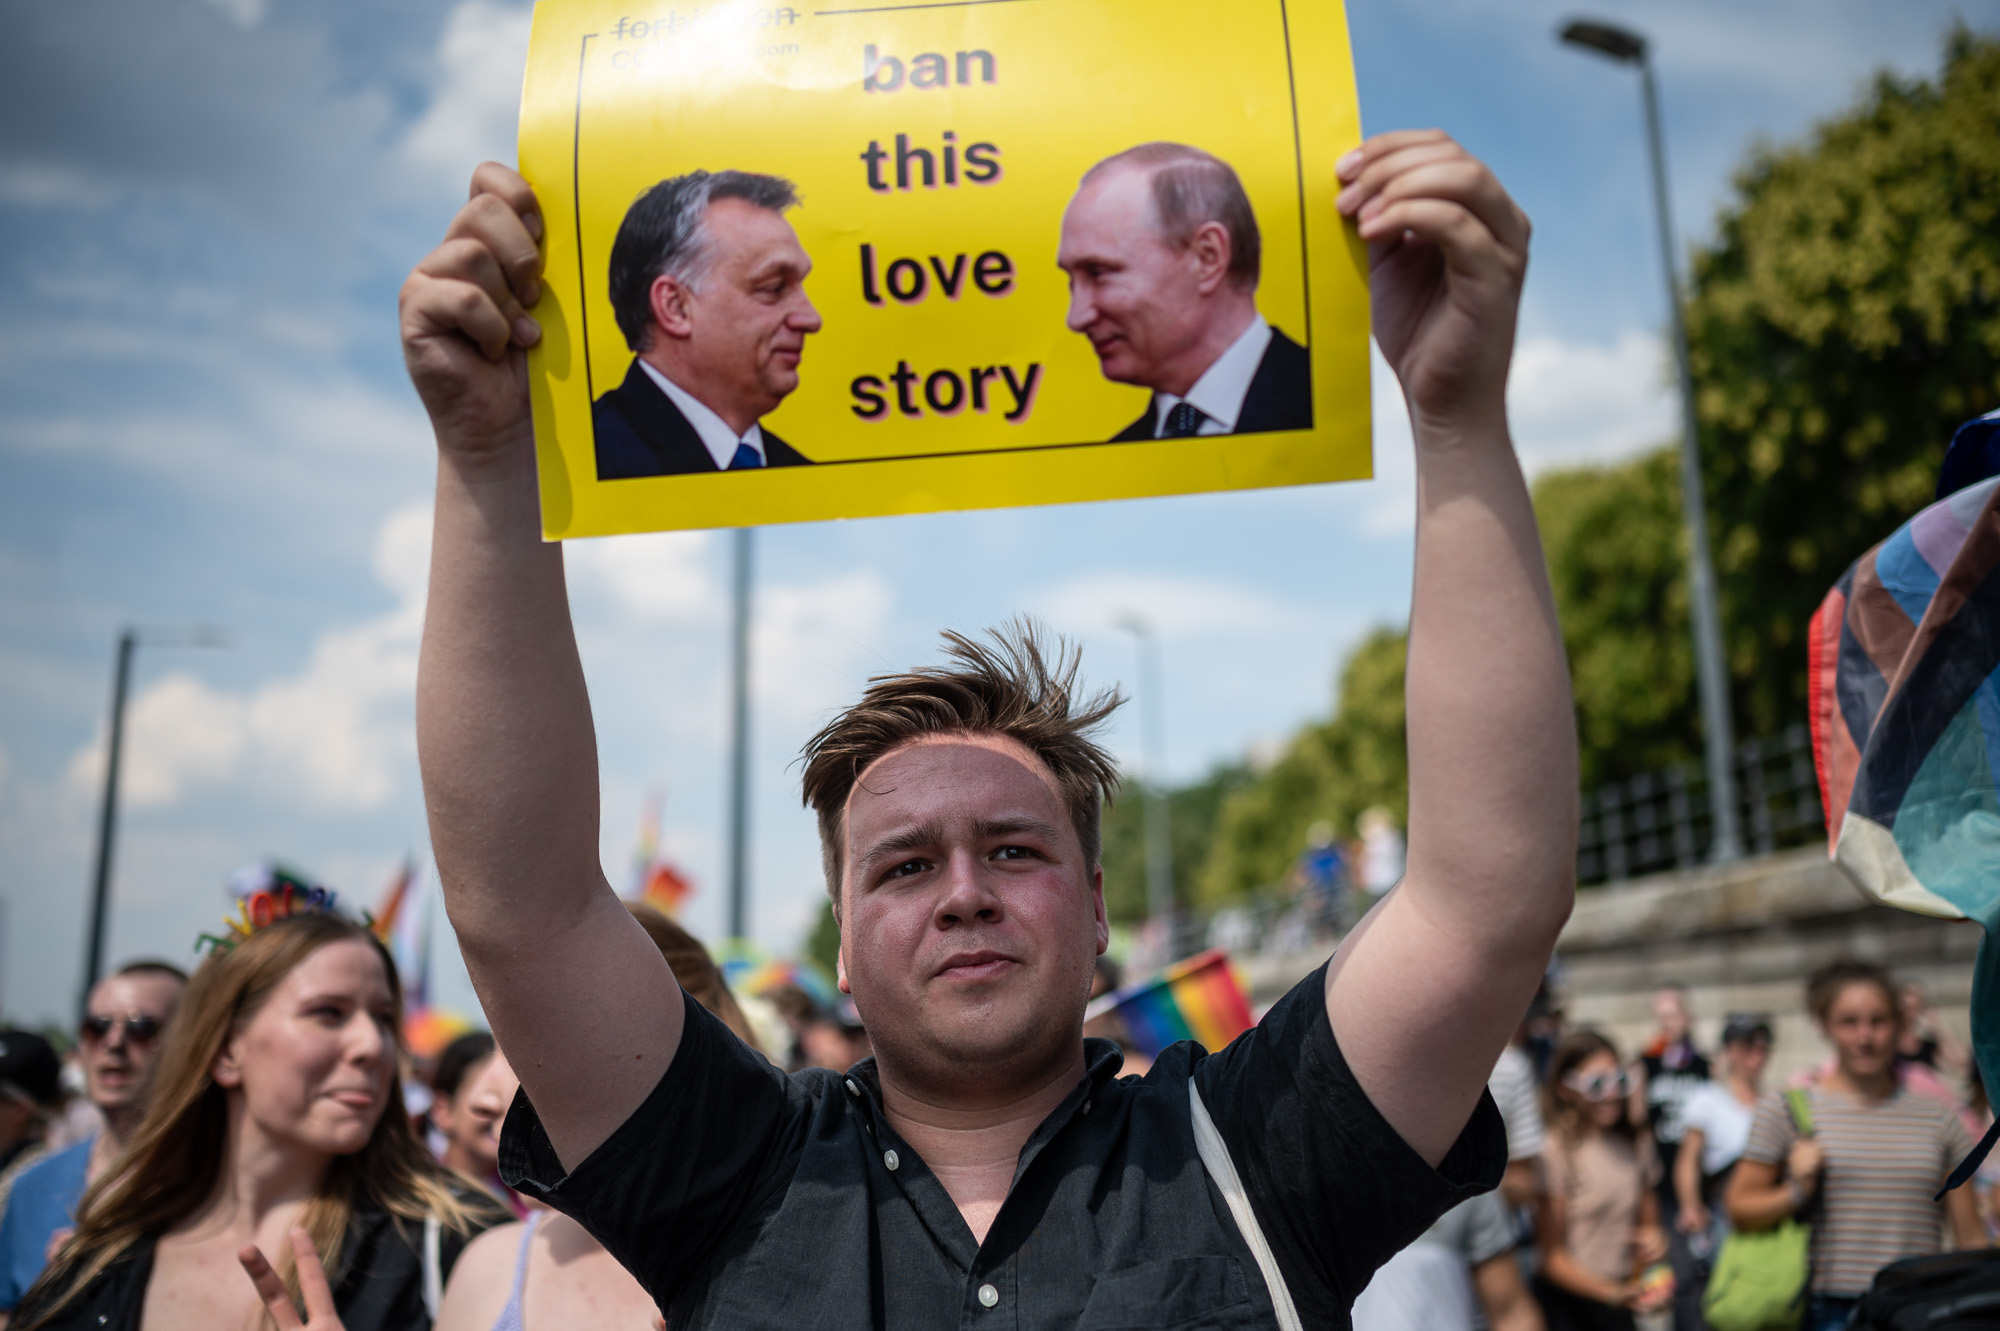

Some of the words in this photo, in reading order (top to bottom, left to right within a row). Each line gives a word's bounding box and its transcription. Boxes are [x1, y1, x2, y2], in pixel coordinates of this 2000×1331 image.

[863, 43, 997, 92] ban
[859, 130, 1002, 193] this
[859, 243, 1016, 307] love
[850, 360, 1044, 424] story
